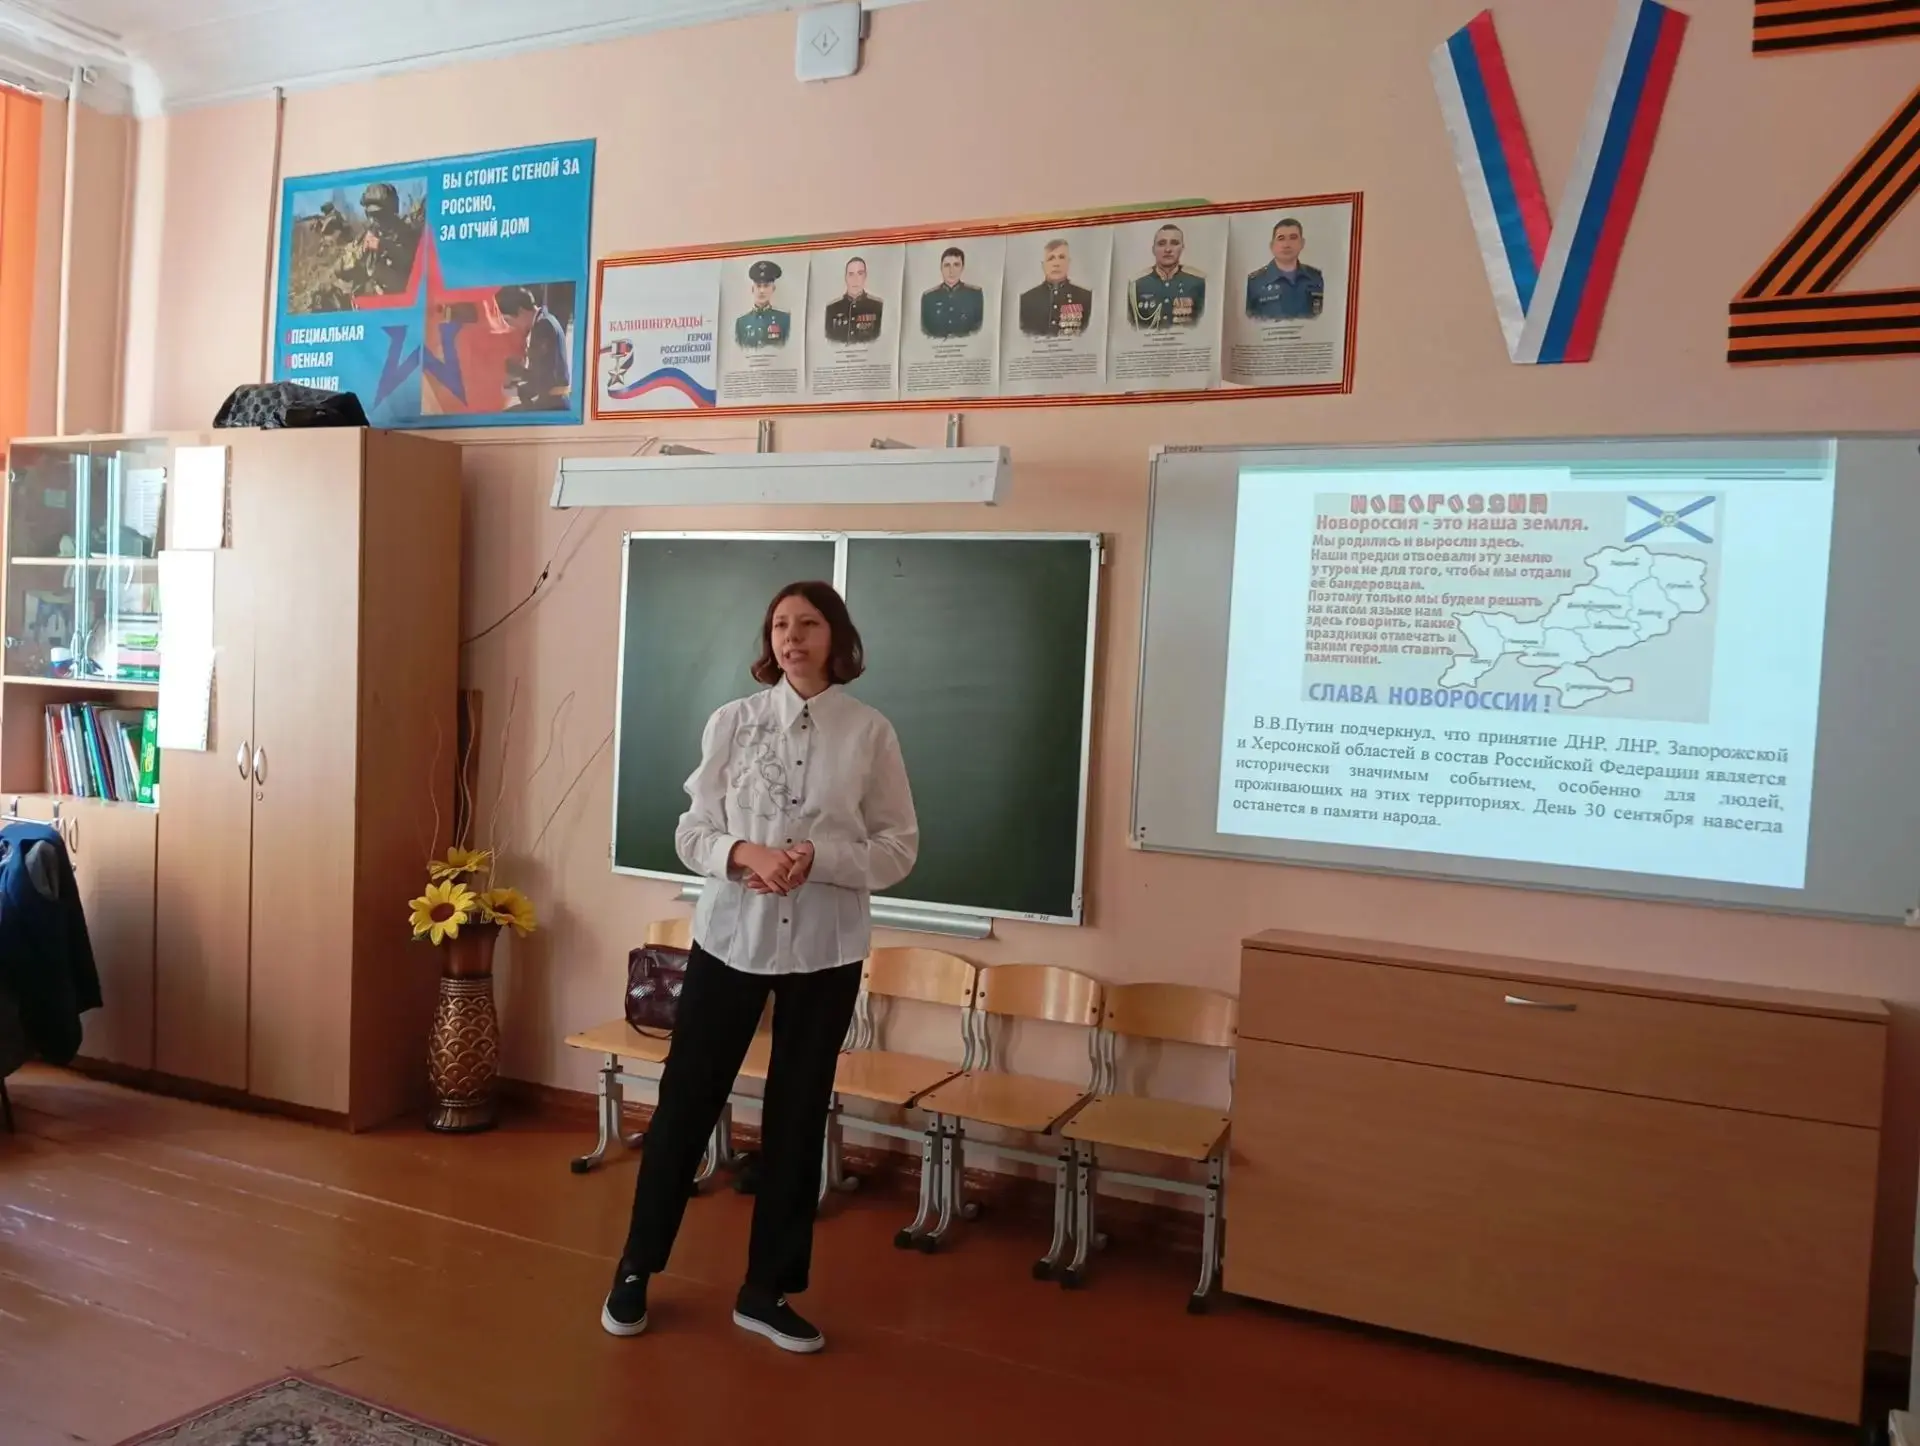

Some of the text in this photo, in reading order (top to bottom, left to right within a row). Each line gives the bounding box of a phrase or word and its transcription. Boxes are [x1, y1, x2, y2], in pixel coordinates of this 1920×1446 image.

[442, 157, 580, 190] ВЫ СТОИТЕ СТЕНОЙ ЗА
[441, 194, 496, 216] РОССИЮ,
[440, 216, 529, 242] ЗА ОТЧИЙ ДОМ
[609, 316, 703, 332] КАЛИНИНГРАДЦЫ
[687, 332, 712, 342] ГЕРОИ
[660, 343, 711, 355] РОССИЙСКОЙ
[662, 355, 710, 366] ФЕДЕРАЦИИ
[1316, 514, 1419, 533] Новороссия
[1433, 517, 1463, 530] это
[1467, 517, 1517, 531] наша
[1523, 518, 1589, 531] земля.
[1312, 534, 1525, 550] Мы родились и выросли здесь.
[1311, 548, 1553, 566] Наши предки отвоевали эту землю
[1311, 565, 1571, 580] у турок не для того, чтобы мы отдали
[1329, 578, 1425, 593] бандеровцам.
[1308, 589, 1543, 608] Поэтому только мы будем решать
[1307, 604, 1443, 617] на каком языке нам
[1306, 616, 1343, 627] здесь
[1345, 617, 1411, 630] говорить,
[1306, 629, 1457, 643] праздники отмечать и
[1306, 641, 1455, 656] каким героям ставить
[1308, 682, 1378, 704] СЛАВА
[1389, 686, 1538, 712] НОВОРОССИИ
[1253, 715, 1334, 734] В.В.Путин
[1444, 730, 1471, 742] что
[1478, 732, 1558, 747] принятие
[1668, 740, 1789, 763] Запорожской
[1237, 736, 1787, 786] и Херсонской областей в состав Российской Федерации является
[1236, 758, 1785, 811] исторически значимым событием, особенно для людей,
[1232, 798, 1442, 827] останется в памяти народа.
[1234, 778, 1783, 834] проживающих на этих территориях. День 30 сентября навсегда
